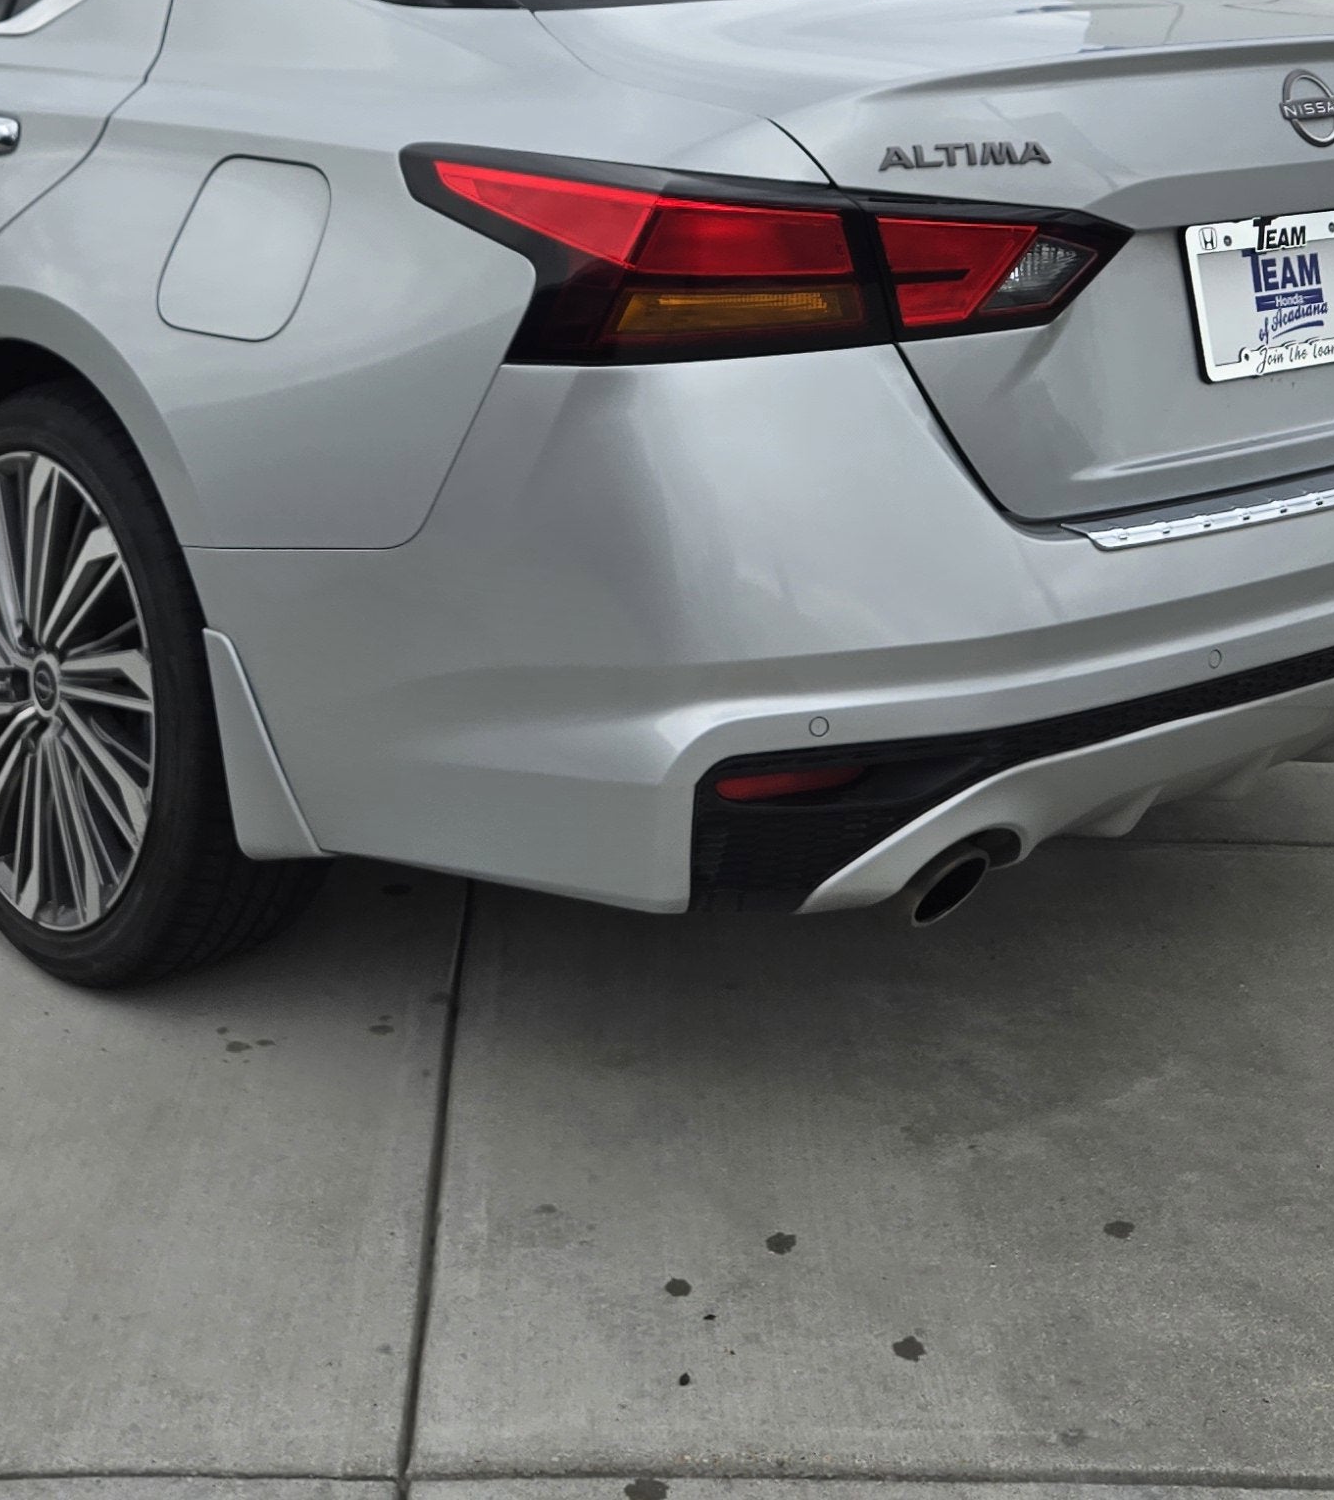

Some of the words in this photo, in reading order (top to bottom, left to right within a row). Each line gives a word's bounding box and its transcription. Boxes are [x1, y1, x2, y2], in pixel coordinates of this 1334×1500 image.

[878, 140, 1053, 172] ALTIMA
[1253, 216, 1306, 251] TEAM
[1242, 249, 1322, 293] TEAM
[1274, 293, 1305, 308] Honda
[1259, 317, 1269, 345] of
[1271, 301, 1328, 331] Acadiana
[1256, 347, 1284, 374] Join
